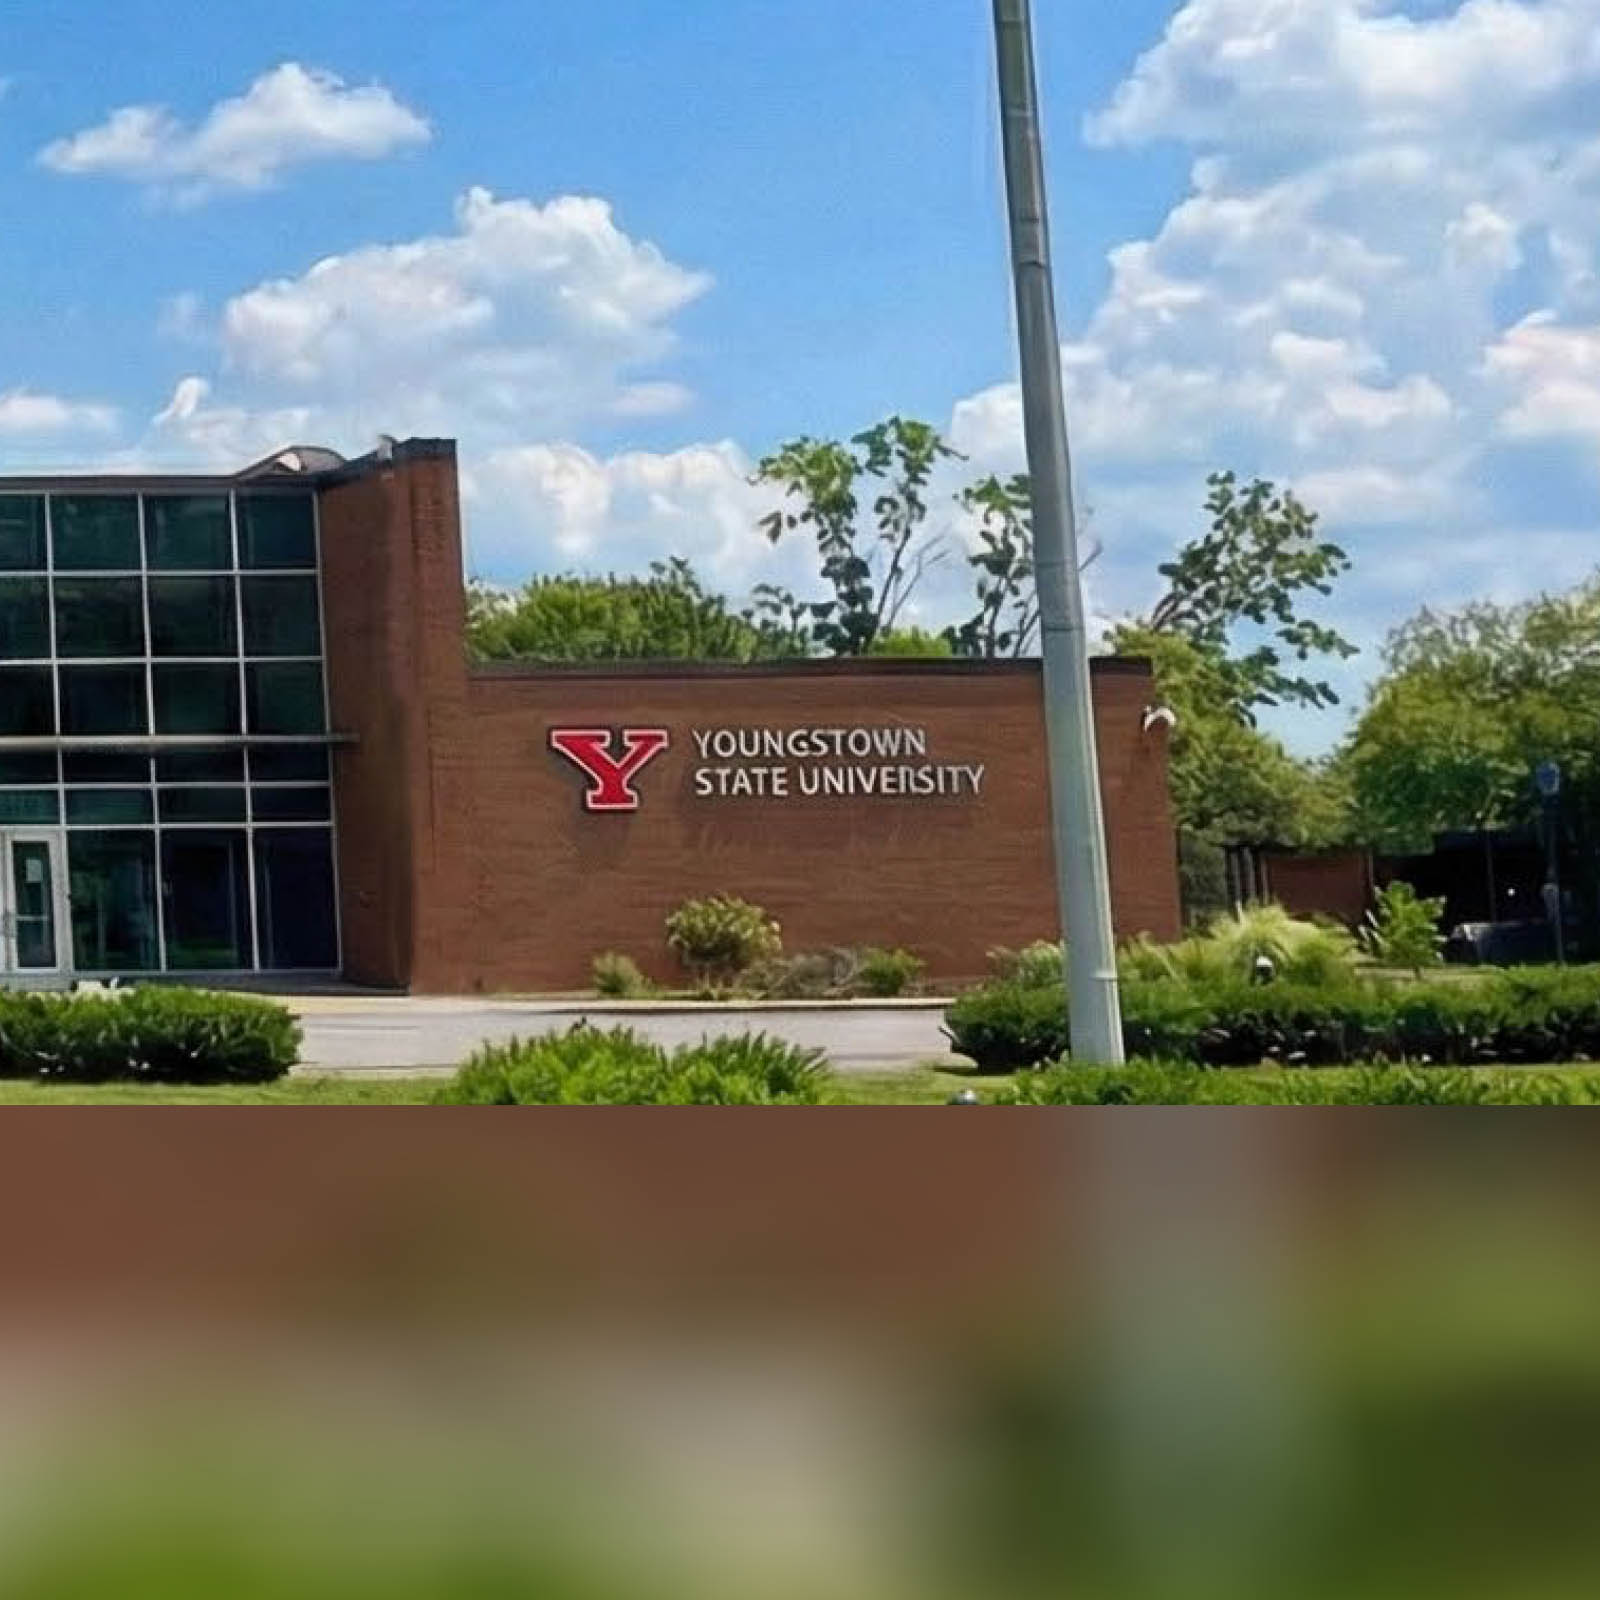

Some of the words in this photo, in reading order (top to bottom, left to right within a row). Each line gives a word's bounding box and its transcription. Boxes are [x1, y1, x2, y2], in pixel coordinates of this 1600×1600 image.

[692, 727, 927, 759] YOUNGSTOWN
[549, 728, 669, 811] Y
[694, 766, 789, 796] STATE
[798, 764, 986, 796] UNIVERSITY
